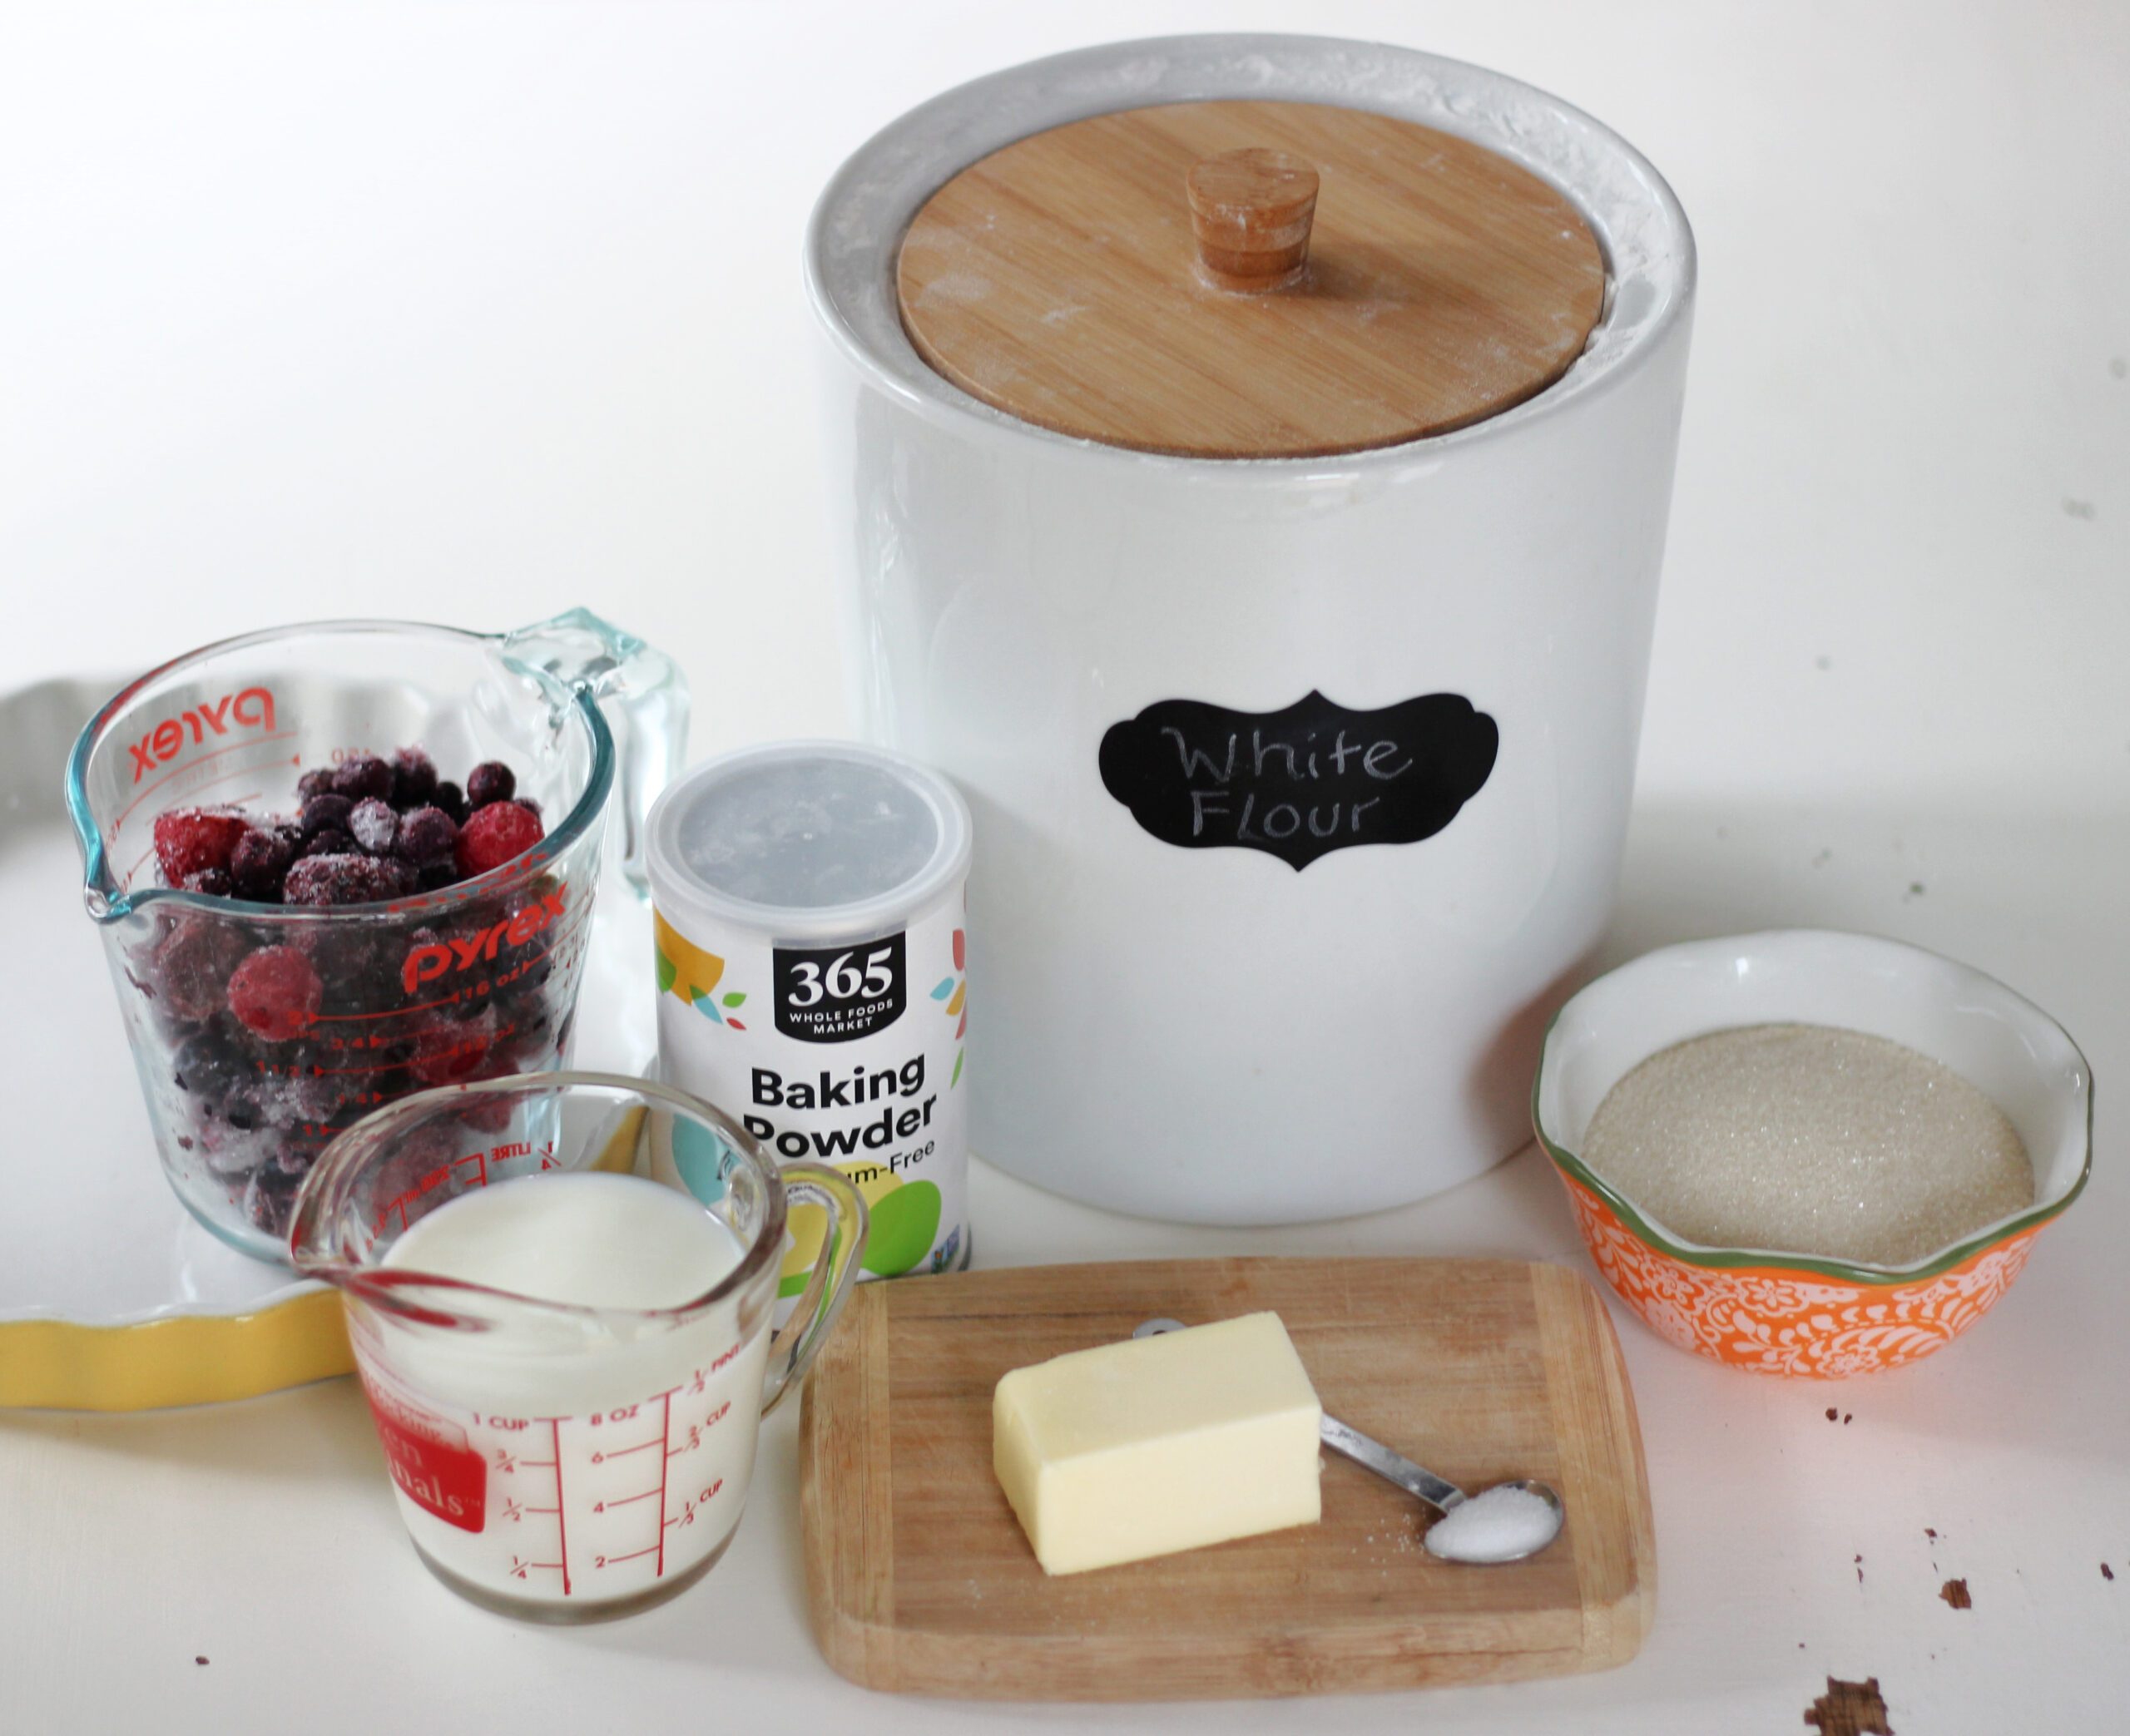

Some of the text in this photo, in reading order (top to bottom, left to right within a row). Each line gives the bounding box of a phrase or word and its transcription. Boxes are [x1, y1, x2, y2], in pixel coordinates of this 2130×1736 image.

[1162, 727, 1413, 784] White
[403, 881, 567, 993] pyrex
[788, 947, 893, 1006] 365
[790, 998, 893, 1023] WHOLE FOODS
[814, 1017, 873, 1035] MARKET
[751, 1053, 925, 1110] Baking
[743, 1093, 937, 1158] Powder
[846, 1140, 935, 1185] m-Free
[489, 1417, 529, 1430] CUP
[591, 1405, 640, 1426] 8 OZ
[706, 1401, 731, 1427] CUP
[592, 1452, 604, 1464] 6
[700, 1478, 723, 1504] CUP
[594, 1501, 604, 1513] 4
[595, 1555, 606, 1569] 2
